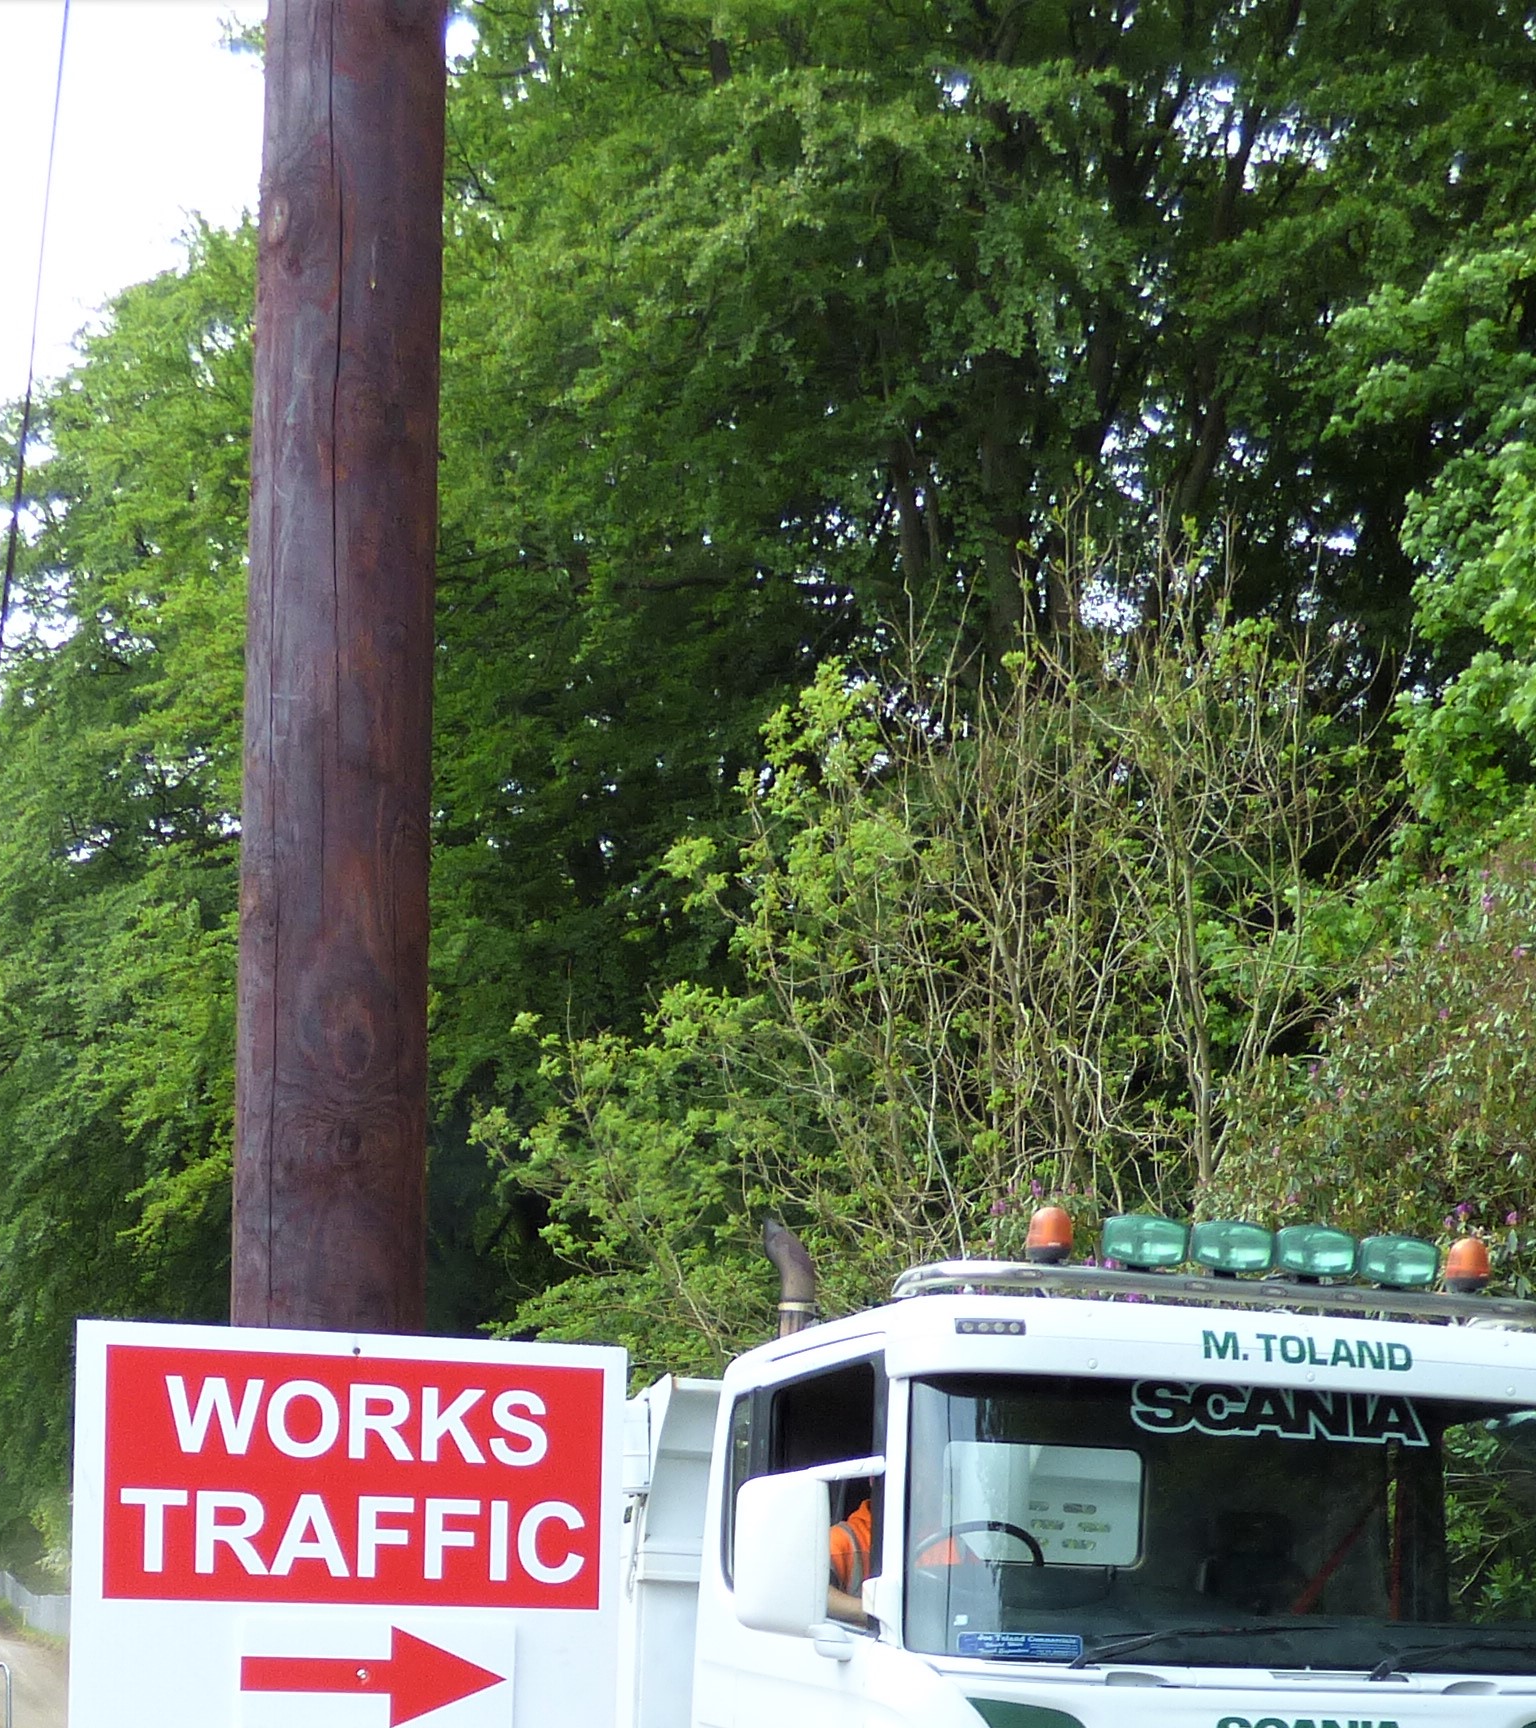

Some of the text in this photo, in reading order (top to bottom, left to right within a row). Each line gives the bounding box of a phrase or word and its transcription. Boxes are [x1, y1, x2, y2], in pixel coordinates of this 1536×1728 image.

[1202, 1330, 1413, 1371] M. TOLAND
[165, 1375, 548, 1467] WORKS
[1130, 1378, 1430, 1447] SCANIA
[120, 1487, 586, 1584] TRAFFIC
